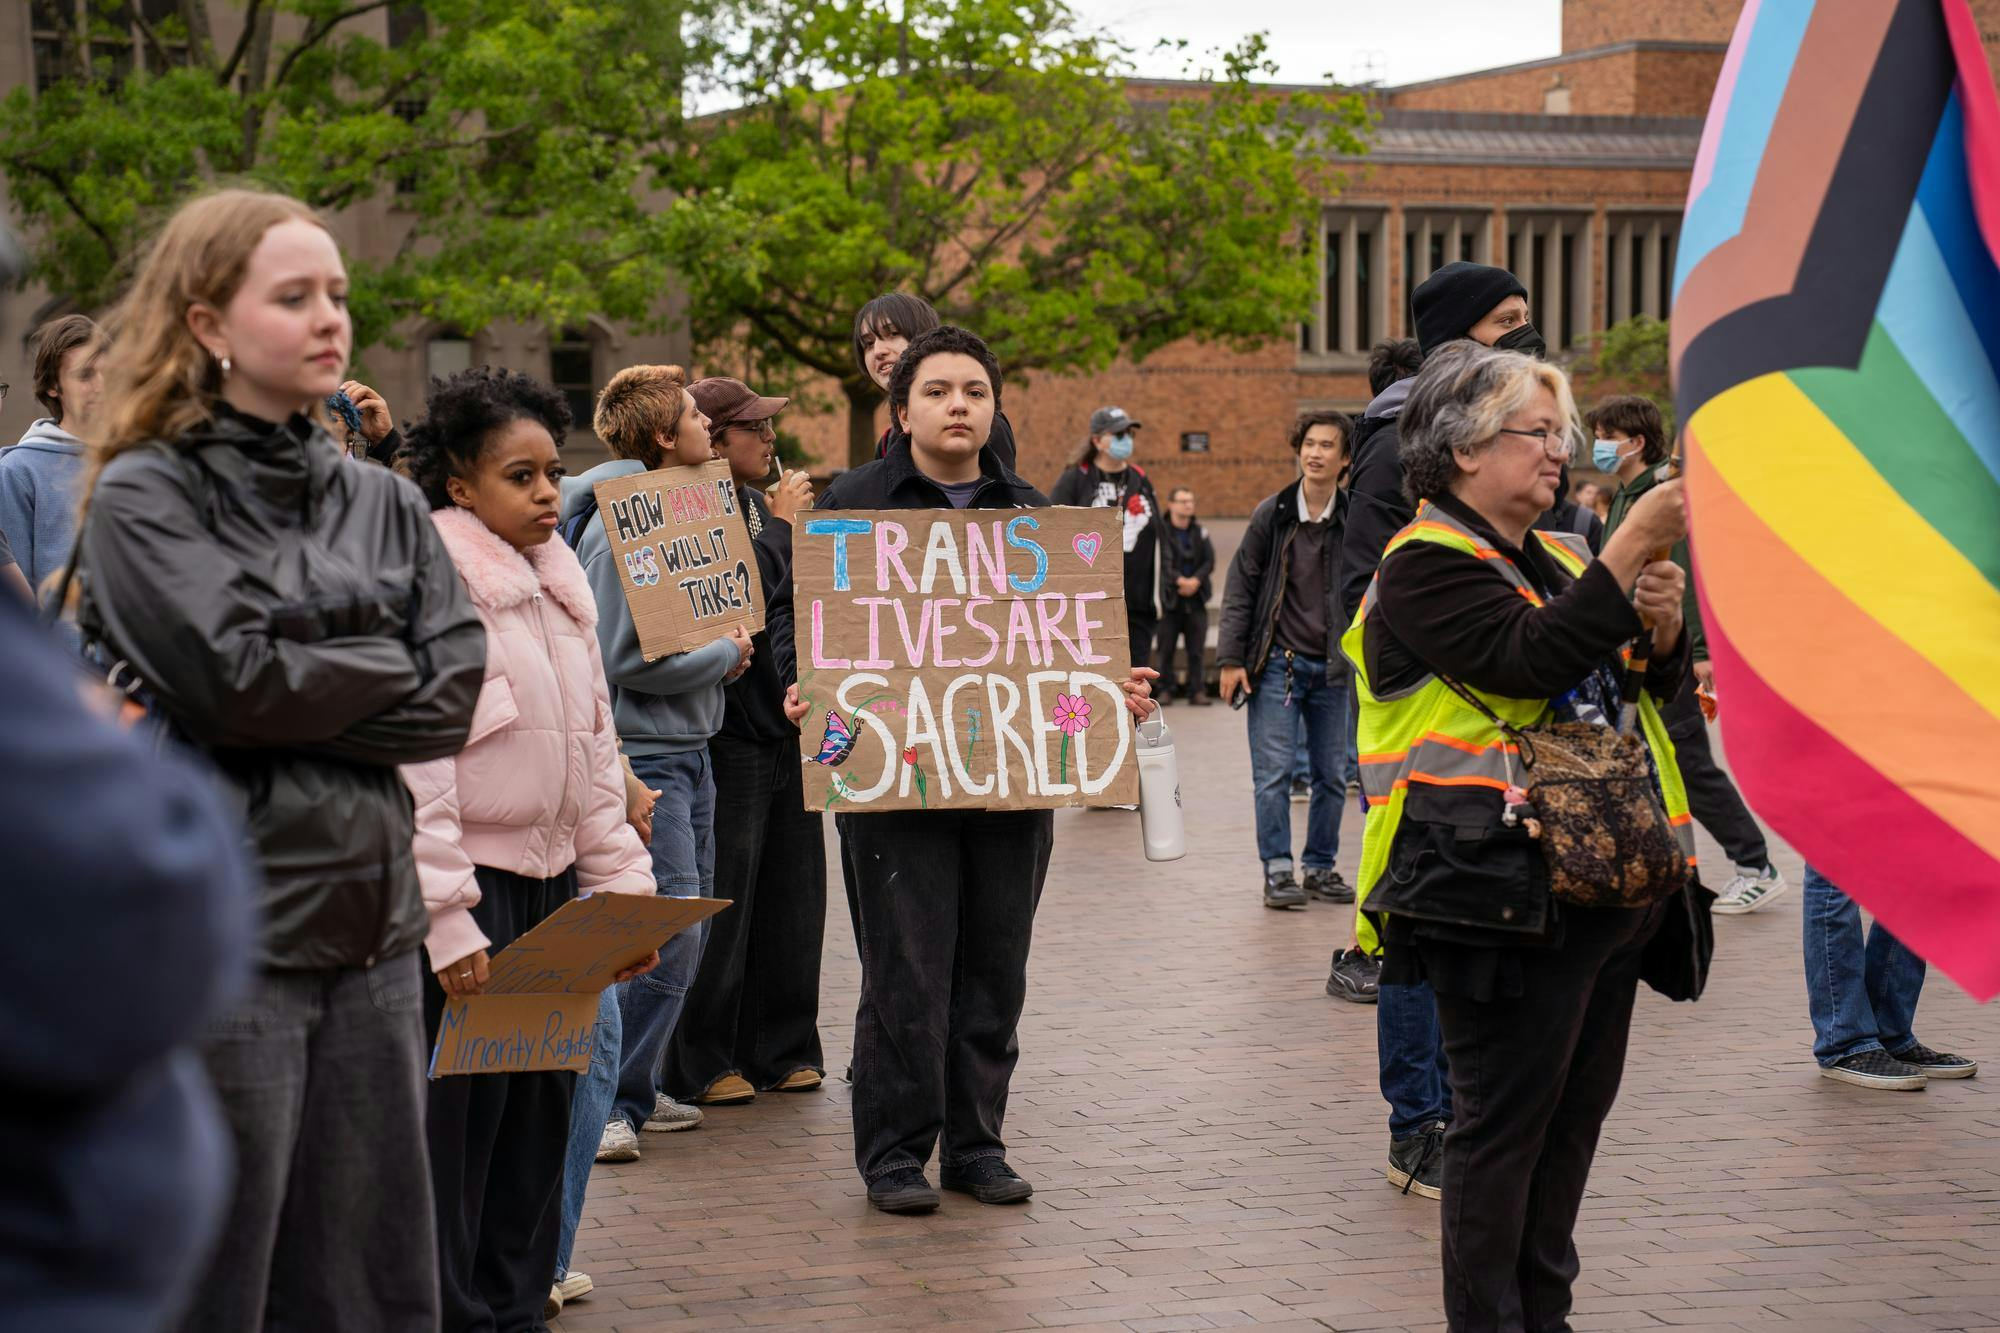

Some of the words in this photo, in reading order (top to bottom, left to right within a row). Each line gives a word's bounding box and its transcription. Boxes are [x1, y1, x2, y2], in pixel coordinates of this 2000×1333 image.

[610, 490, 665, 543] HOW
[667, 481, 721, 525] MANY
[717, 478, 736, 516] OF
[624, 545, 660, 587] US
[658, 534, 712, 575] WILL
[708, 526, 730, 563] IT
[678, 559, 755, 620] TAKE?
[804, 515, 1048, 597] TRANS
[812, 596, 1000, 670] LIVES
[1006, 591, 1110, 667] ARE
[832, 672, 1130, 799] SACRED
[433, 1002, 536, 1072] Minority
